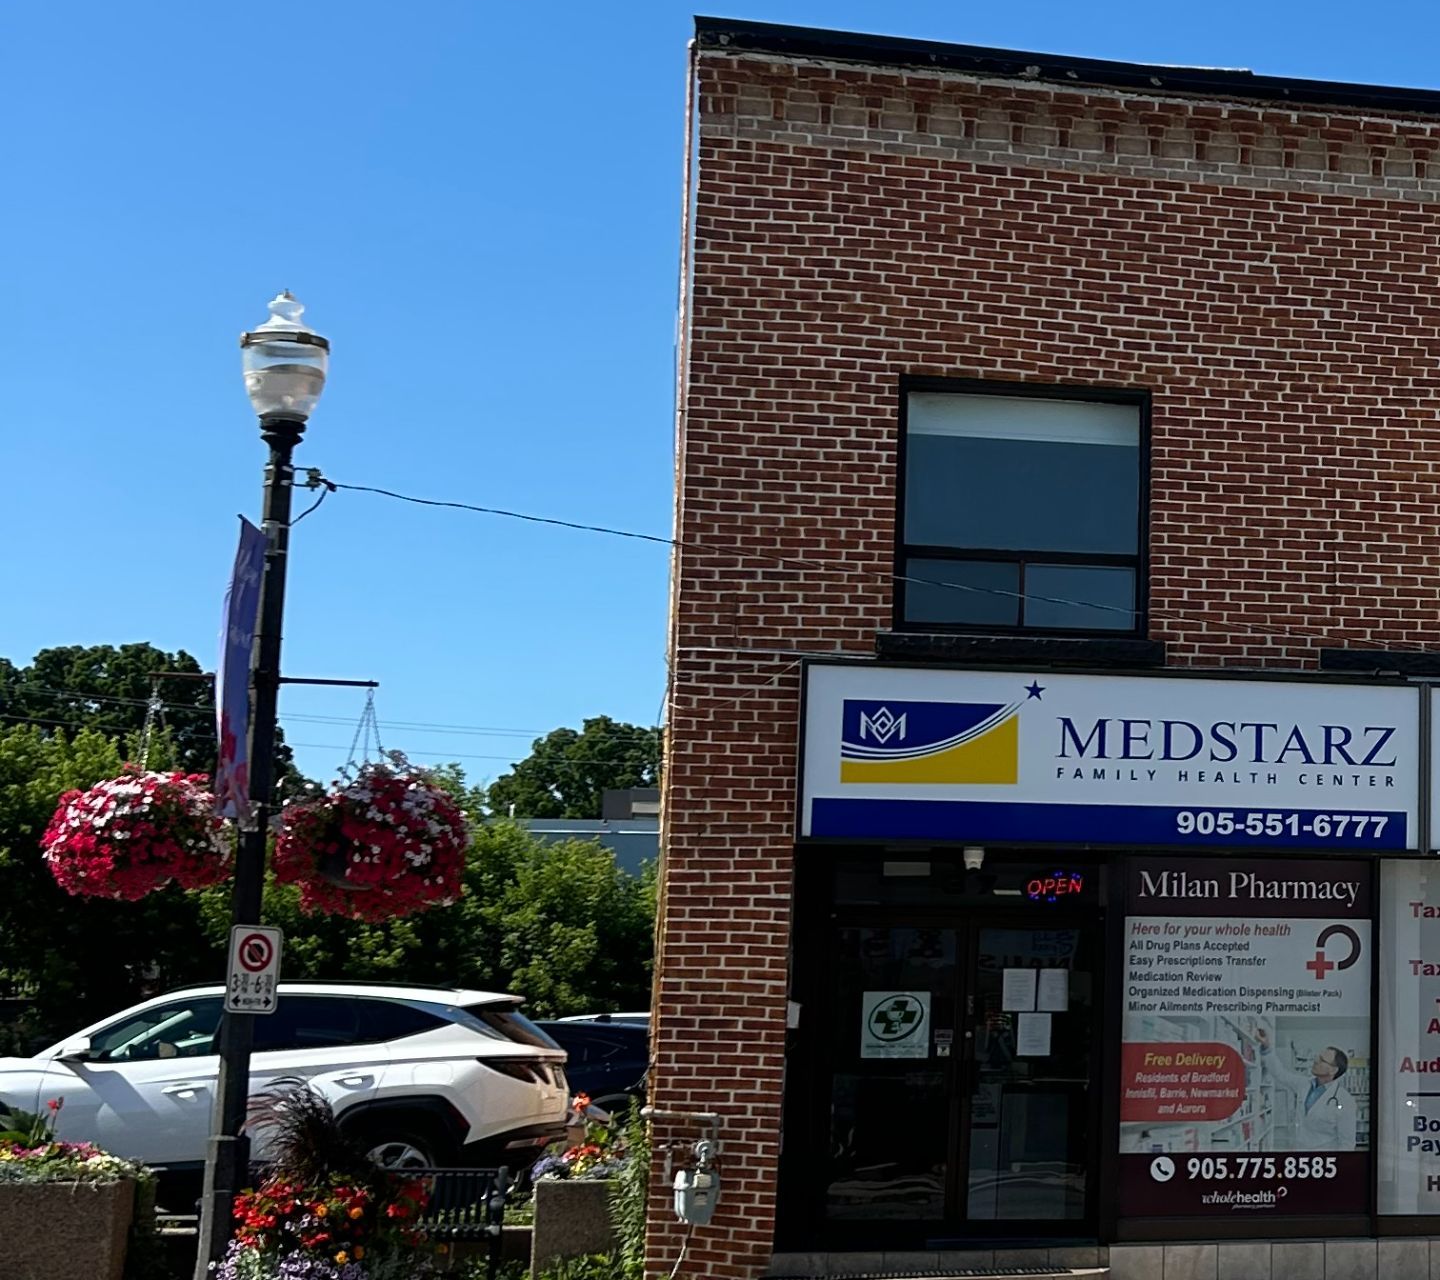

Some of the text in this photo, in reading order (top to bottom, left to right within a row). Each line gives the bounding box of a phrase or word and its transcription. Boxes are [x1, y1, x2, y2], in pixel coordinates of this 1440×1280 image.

[1056, 716, 1398, 767] MEDSTARZ
[1057, 767, 1396, 788] FAMILY HEALTH CENTER
[1176, 810, 1389, 839] 905-551-6777
[1027, 877, 1083, 897] OPEN
[1138, 871, 1361, 907] Milan Pharmacy
[1131, 922, 1291, 938] Here for your whole health
[1130, 940, 1250, 953] All Drug Plans Accepted
[1129, 955, 1266, 968] Easy Prescriptions Transfer
[1129, 971, 1222, 982] Medication Review
[1128, 987, 1181, 999] Organized
[1183, 987, 1236, 997] Medication
[1239, 987, 1294, 999] Dispensing
[1128, 1001, 1321, 1013] Minor Ailments Prescribing Pharmacist
[1144, 1052, 1226, 1069] Free Delivery
[1135, 1072, 1231, 1083] Residents of Bradford
[1157, 1103, 1206, 1114] and Aurora
[1187, 1156, 1338, 1180] 905.775.8585
